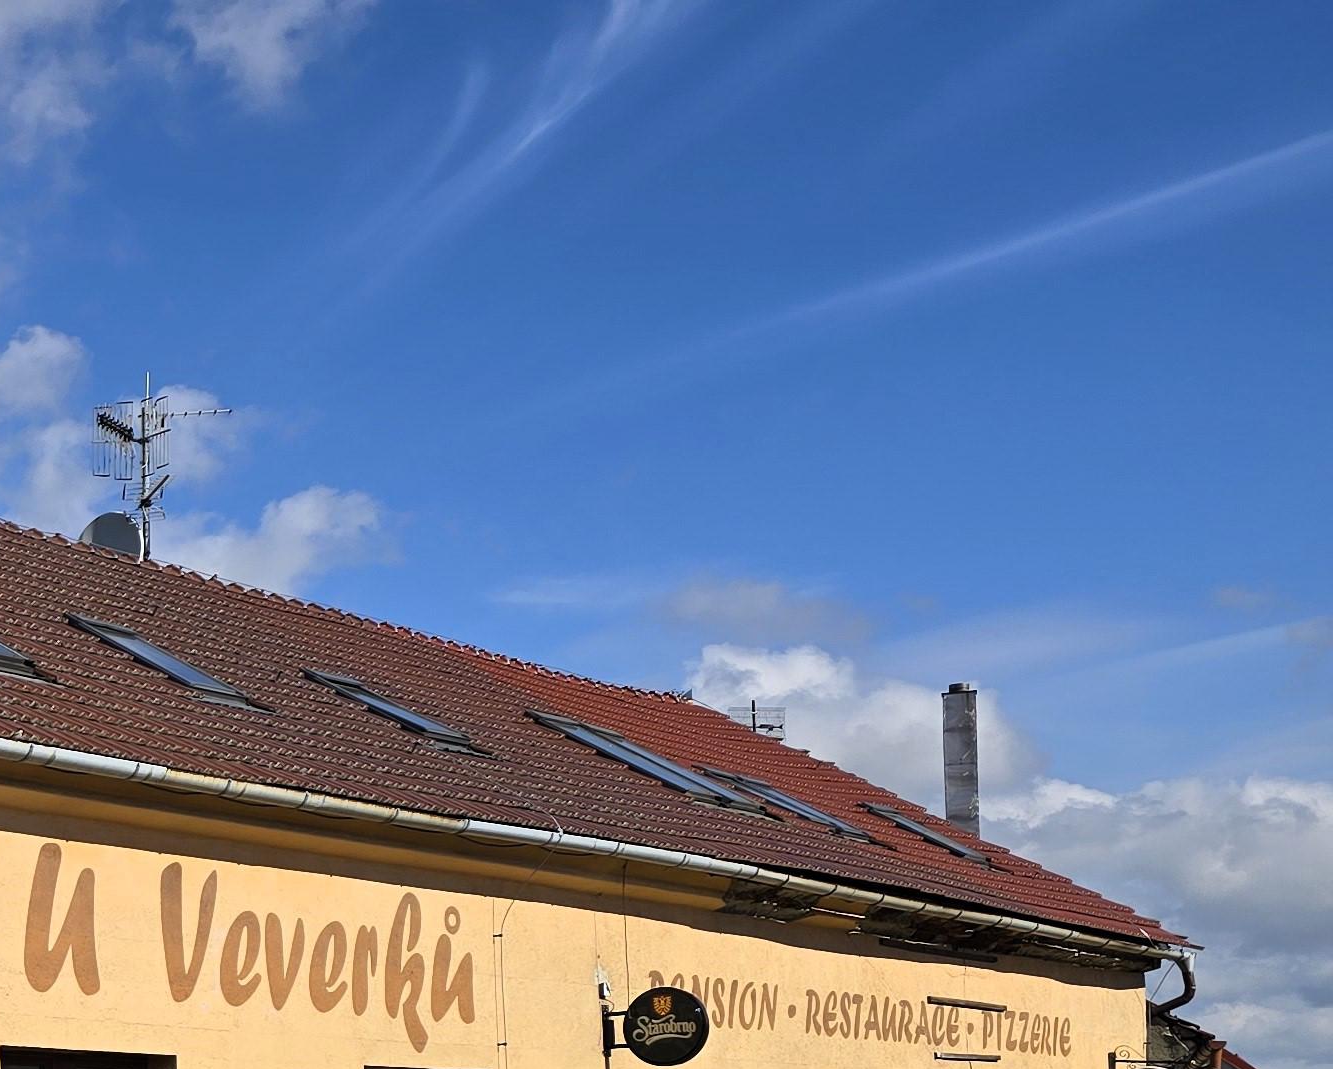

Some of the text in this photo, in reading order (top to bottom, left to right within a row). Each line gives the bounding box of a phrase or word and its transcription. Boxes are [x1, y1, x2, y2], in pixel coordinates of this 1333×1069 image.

[23, 842, 476, 1054] U Veverků
[632, 1014, 697, 1046] Starobrno
[804, 988, 960, 1048] RESTAURACE
[982, 1009, 1072, 1058] PIZZERIE
